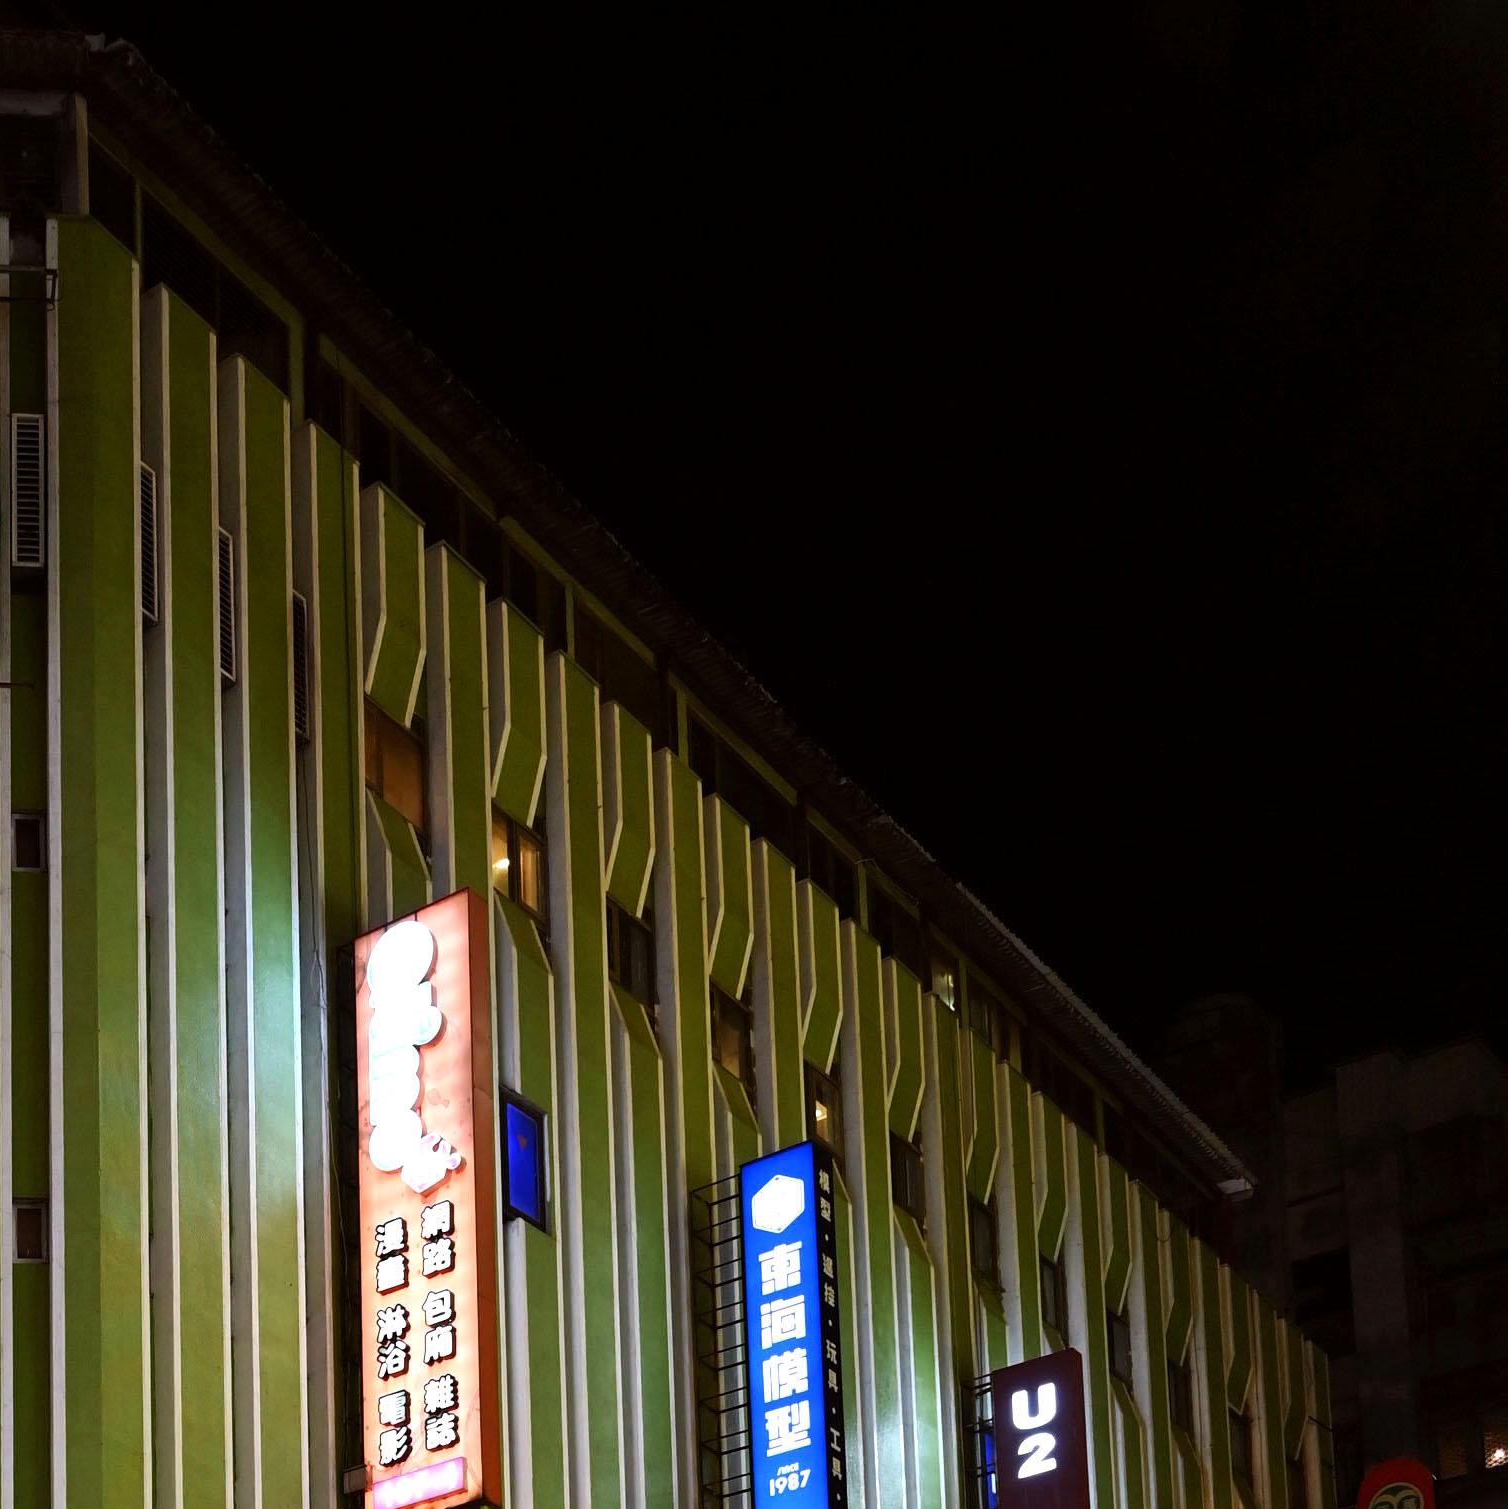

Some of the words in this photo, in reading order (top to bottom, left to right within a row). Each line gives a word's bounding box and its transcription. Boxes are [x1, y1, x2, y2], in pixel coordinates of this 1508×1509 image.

[758, 1240, 812, 1458] 東海模型
[1011, 1382, 1057, 1480] U2
[768, 1472, 812, 1498] 1987
